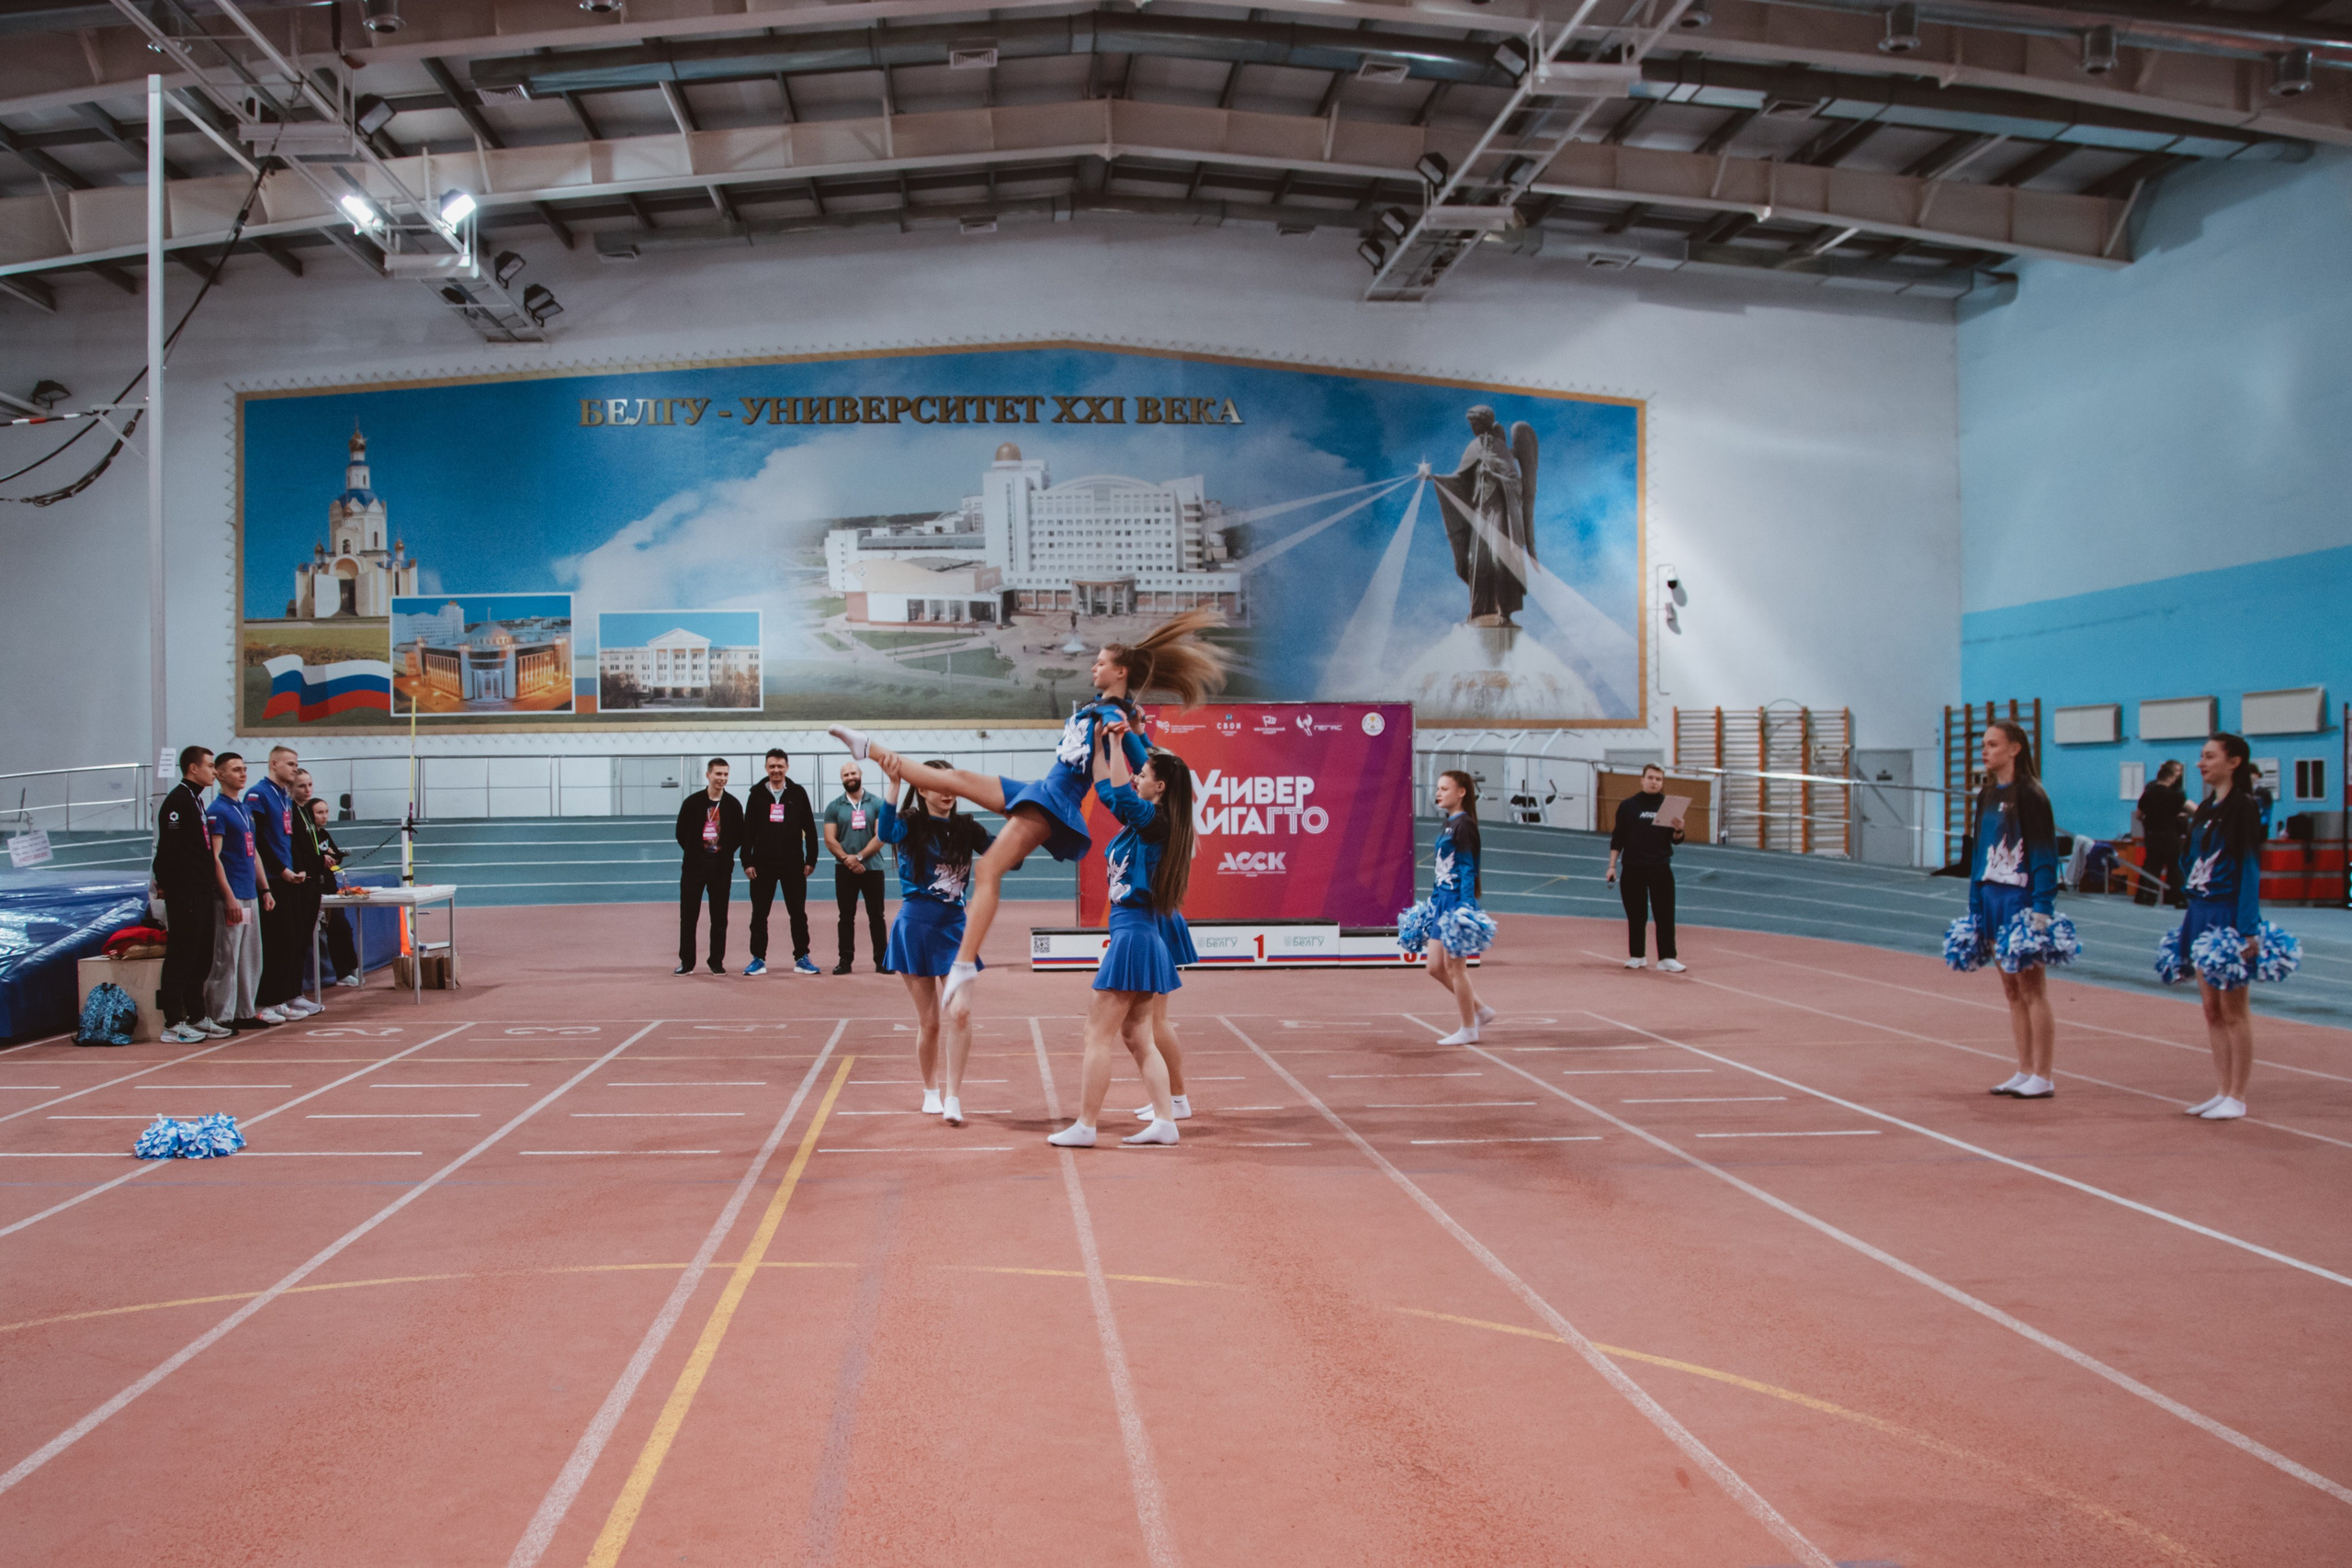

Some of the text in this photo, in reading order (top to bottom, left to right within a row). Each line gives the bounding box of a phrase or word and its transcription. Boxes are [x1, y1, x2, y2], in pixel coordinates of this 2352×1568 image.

[578, 398, 711, 426] БЕЛГУ
[739, 396, 1046, 425] УНИВЕРСИТЕТ
[1051, 396, 1126, 424] XXI
[1135, 396, 1244, 424] ВЕКА
[1190, 769, 1315, 808] УНИВЕР
[1206, 937, 1238, 948] БелГУ
[1253, 934, 1264, 959] 1
[1294, 936, 1325, 947] БелГУ
